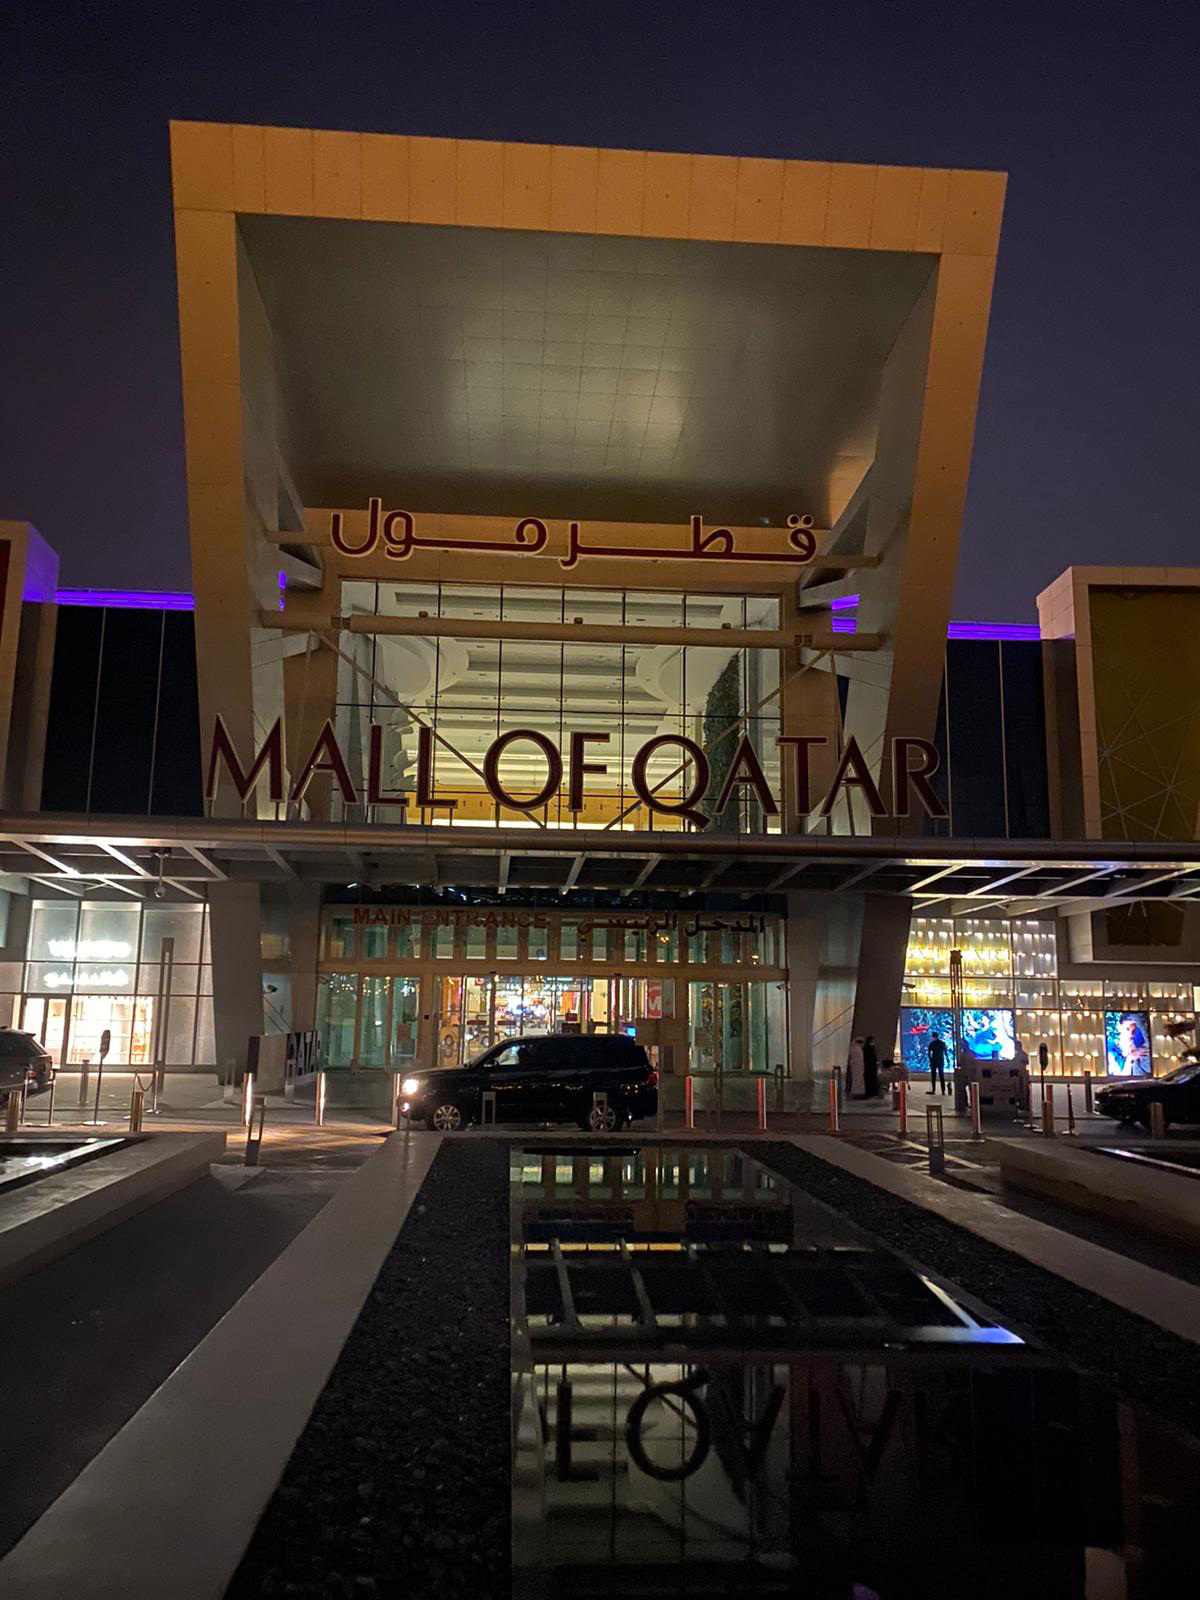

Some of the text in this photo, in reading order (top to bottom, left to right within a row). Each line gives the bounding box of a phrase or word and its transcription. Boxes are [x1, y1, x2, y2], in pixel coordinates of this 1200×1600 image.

[330, 497, 817, 570] قطر مول
[205, 712, 950, 830] MALL OF QATAR
[352, 908, 547, 928] MAIN ENTRANCE
[685, 912, 766, 936] المدخل
